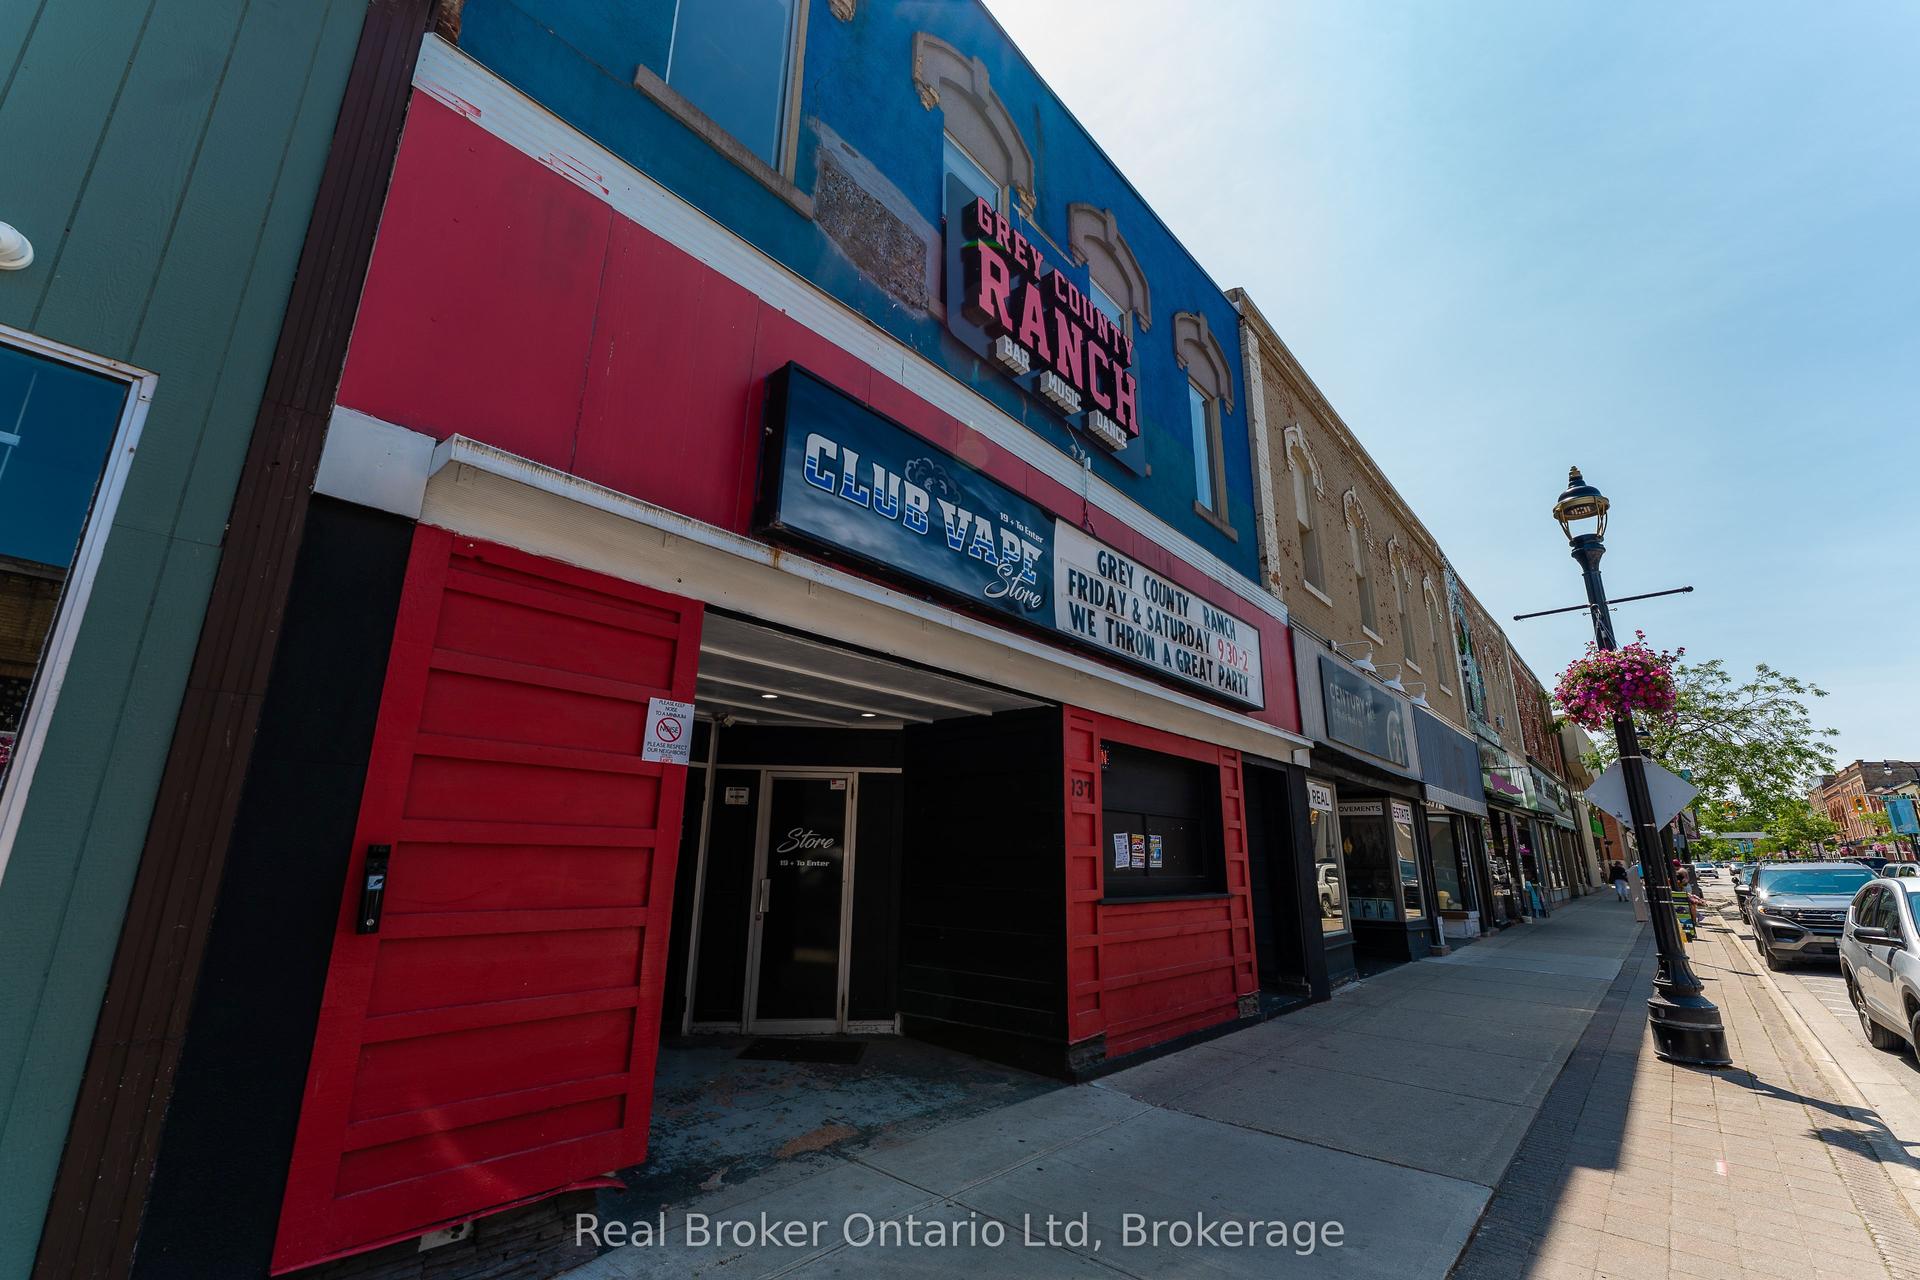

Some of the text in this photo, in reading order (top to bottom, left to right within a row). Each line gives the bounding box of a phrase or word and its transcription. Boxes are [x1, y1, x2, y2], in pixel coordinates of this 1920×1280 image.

[978, 196, 1133, 367] GREY COUNTY
[978, 238, 1139, 437] RANCH
[1004, 336, 1030, 371] BAR
[1048, 371, 1082, 411] MUSIC
[1096, 411, 1127, 448] DANCE
[804, 433, 1043, 585] CLUB VAPE
[999, 512, 1009, 522] 19
[1015, 520, 1024, 531] To
[1024, 526, 1044, 543] Enter
[983, 563, 1042, 608] Store
[1097, 550, 1236, 641] GREY COUNTY RANCH
[1068, 568, 1127, 616] FRIDAY
[1132, 598, 1141, 625] &
[1147, 607, 1211, 653] SATURDAY
[1068, 601, 1248, 697] WE THROW A GREAT PARTY
[1329, 682, 1365, 713] CENTURY
[647, 741, 687, 751] PLEASE RESPECT
[1311, 789, 1329, 807] REAL
[1392, 806, 1410, 821] ESTATE
[776, 828, 834, 853] Store
